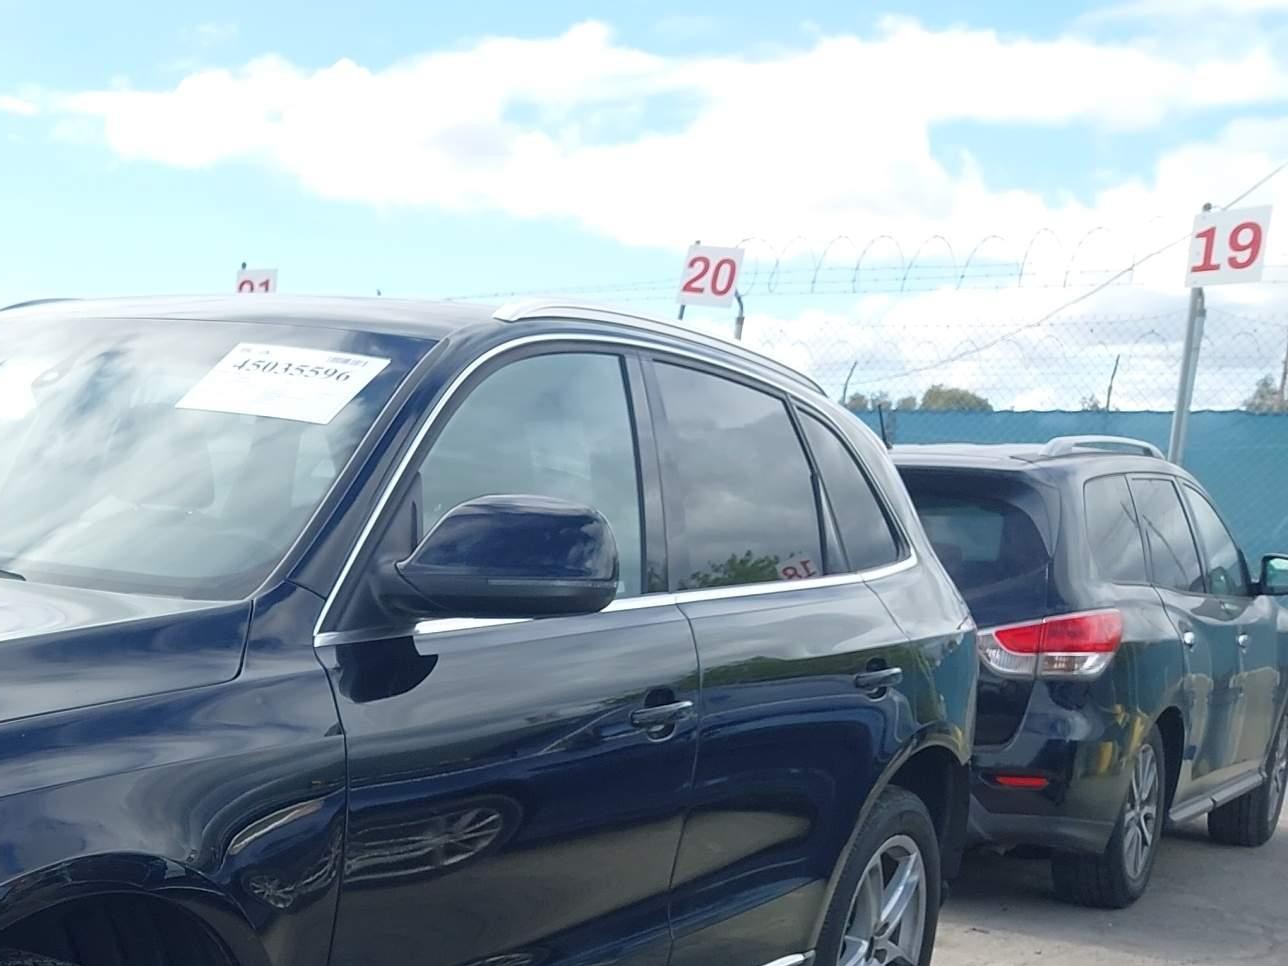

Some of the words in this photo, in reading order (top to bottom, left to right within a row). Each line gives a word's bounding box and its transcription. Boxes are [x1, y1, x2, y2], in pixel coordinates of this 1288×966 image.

[1191, 222, 1263, 273] 19
[681, 256, 737, 296] 20
[232, 359, 351, 381] 45035596
